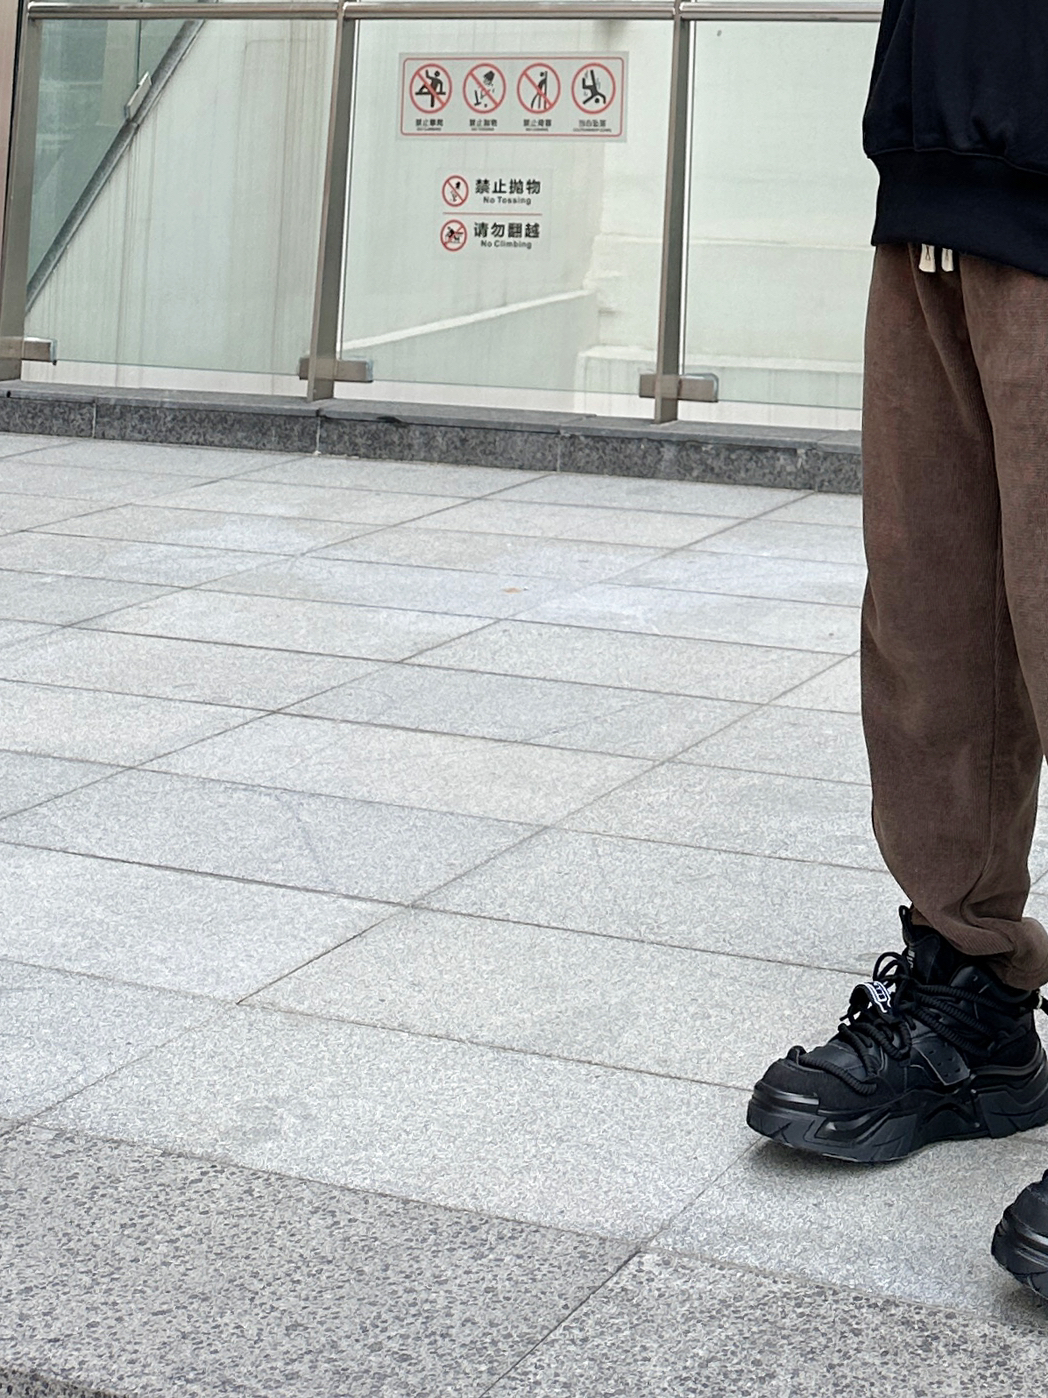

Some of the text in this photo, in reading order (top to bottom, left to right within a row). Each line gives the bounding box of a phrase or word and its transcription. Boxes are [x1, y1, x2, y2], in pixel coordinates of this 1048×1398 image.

[475, 178, 541, 195] 禁止抛物
[483, 196, 532, 205] No Tossing
[473, 222, 540, 238] 请勿翻越
[494, 240, 532, 250] Climbing
